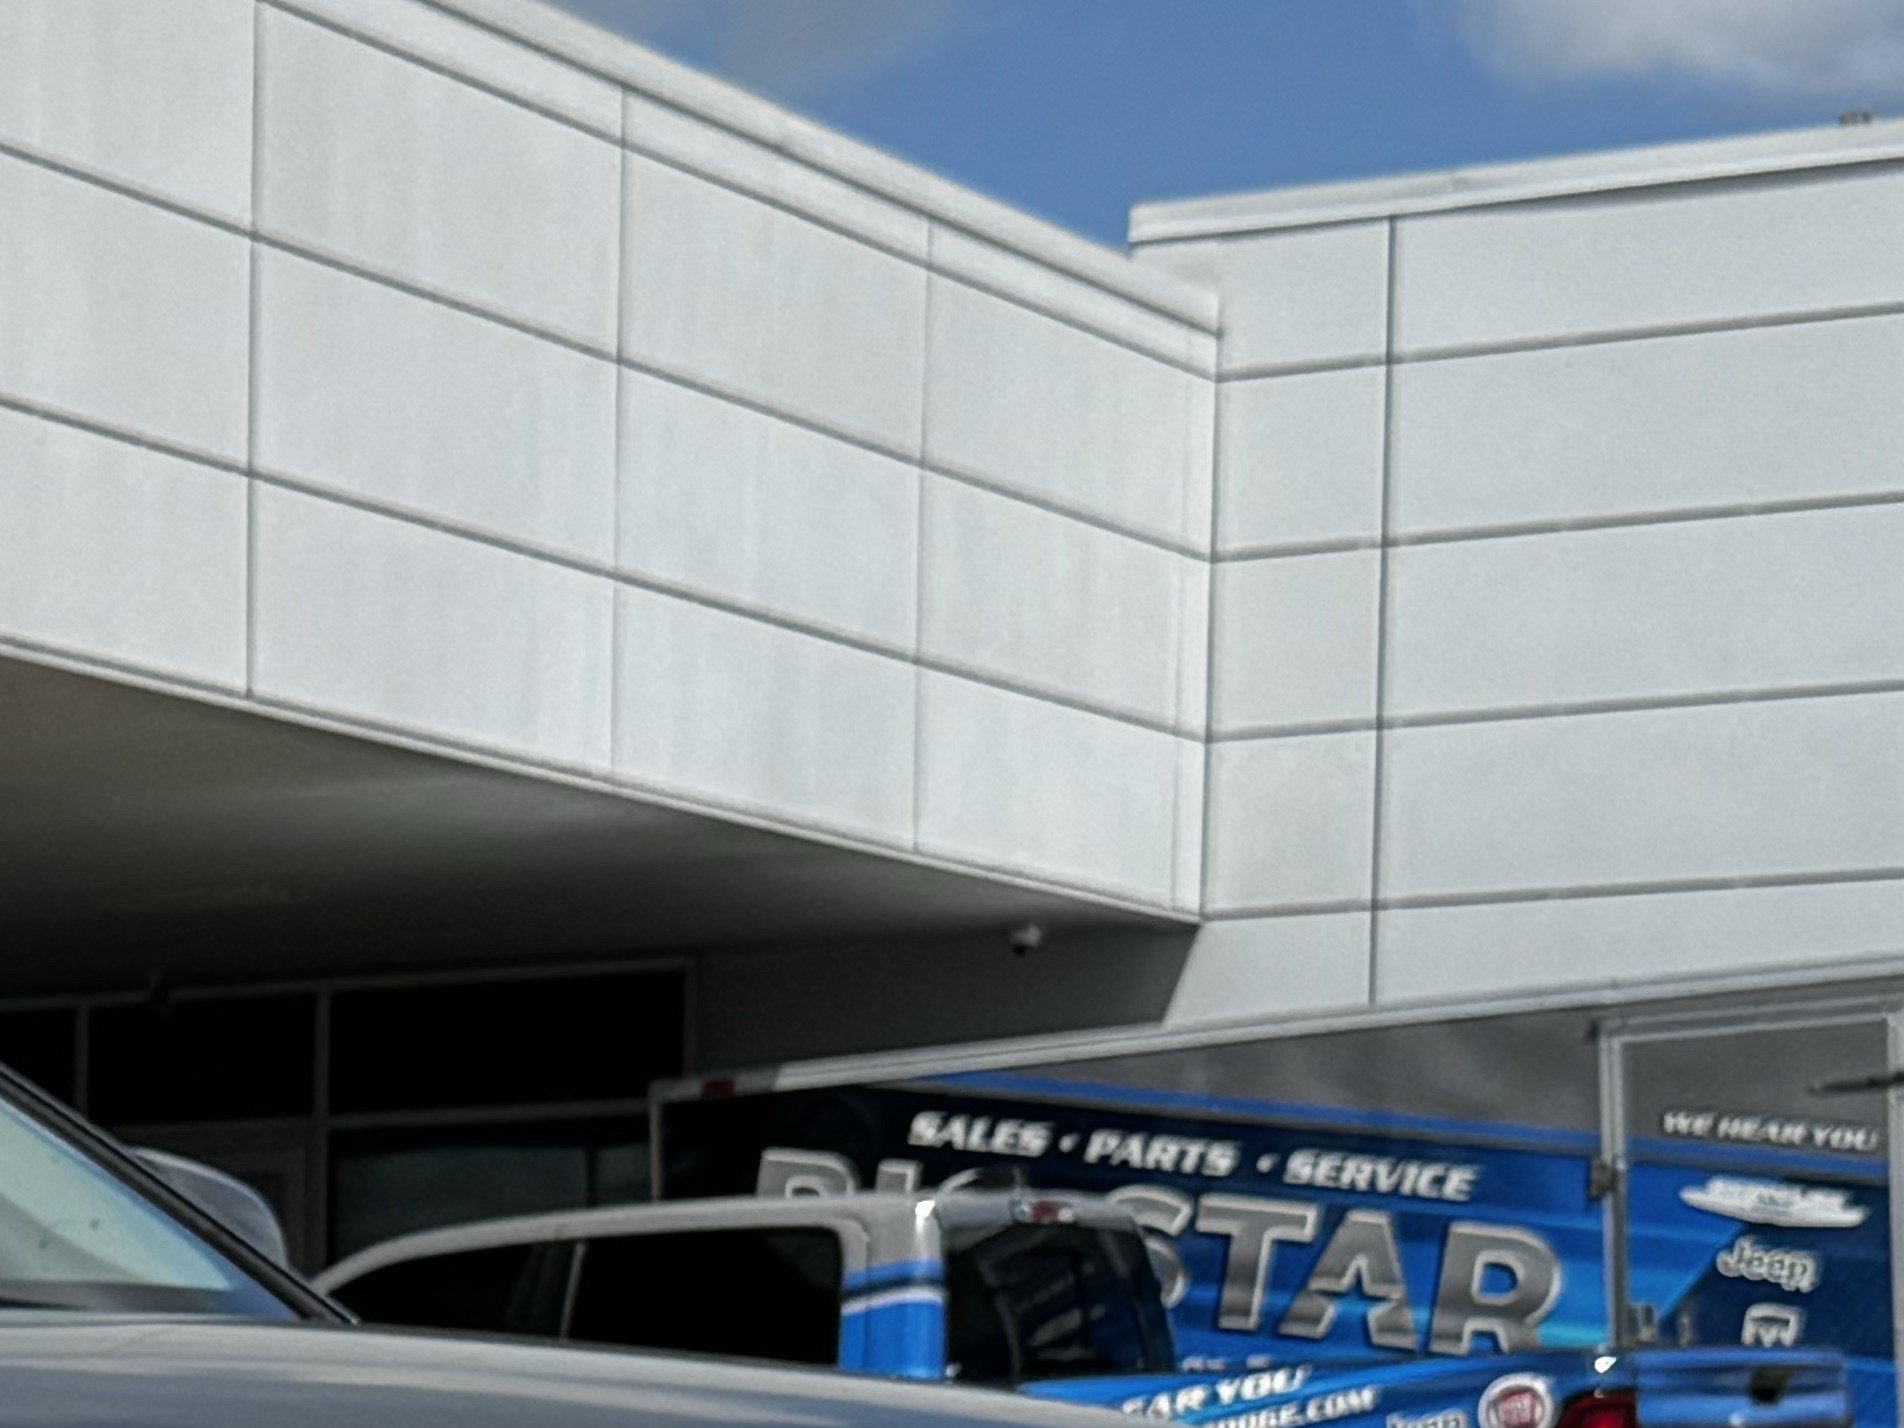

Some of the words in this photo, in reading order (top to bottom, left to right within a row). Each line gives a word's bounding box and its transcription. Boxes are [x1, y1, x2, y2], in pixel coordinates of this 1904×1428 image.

[907, 1110, 1055, 1158] SALES
[1084, 1128, 1242, 1178] PARTS
[1282, 1149, 1482, 1203] SERVICE
[1662, 1111, 1716, 1137] WE
[1812, 1125, 1880, 1150] YOU
[1717, 1236, 1820, 1293] Jeep
[1122, 1383, 1210, 1421] EAR
[1216, 1363, 1313, 1404] YOU
